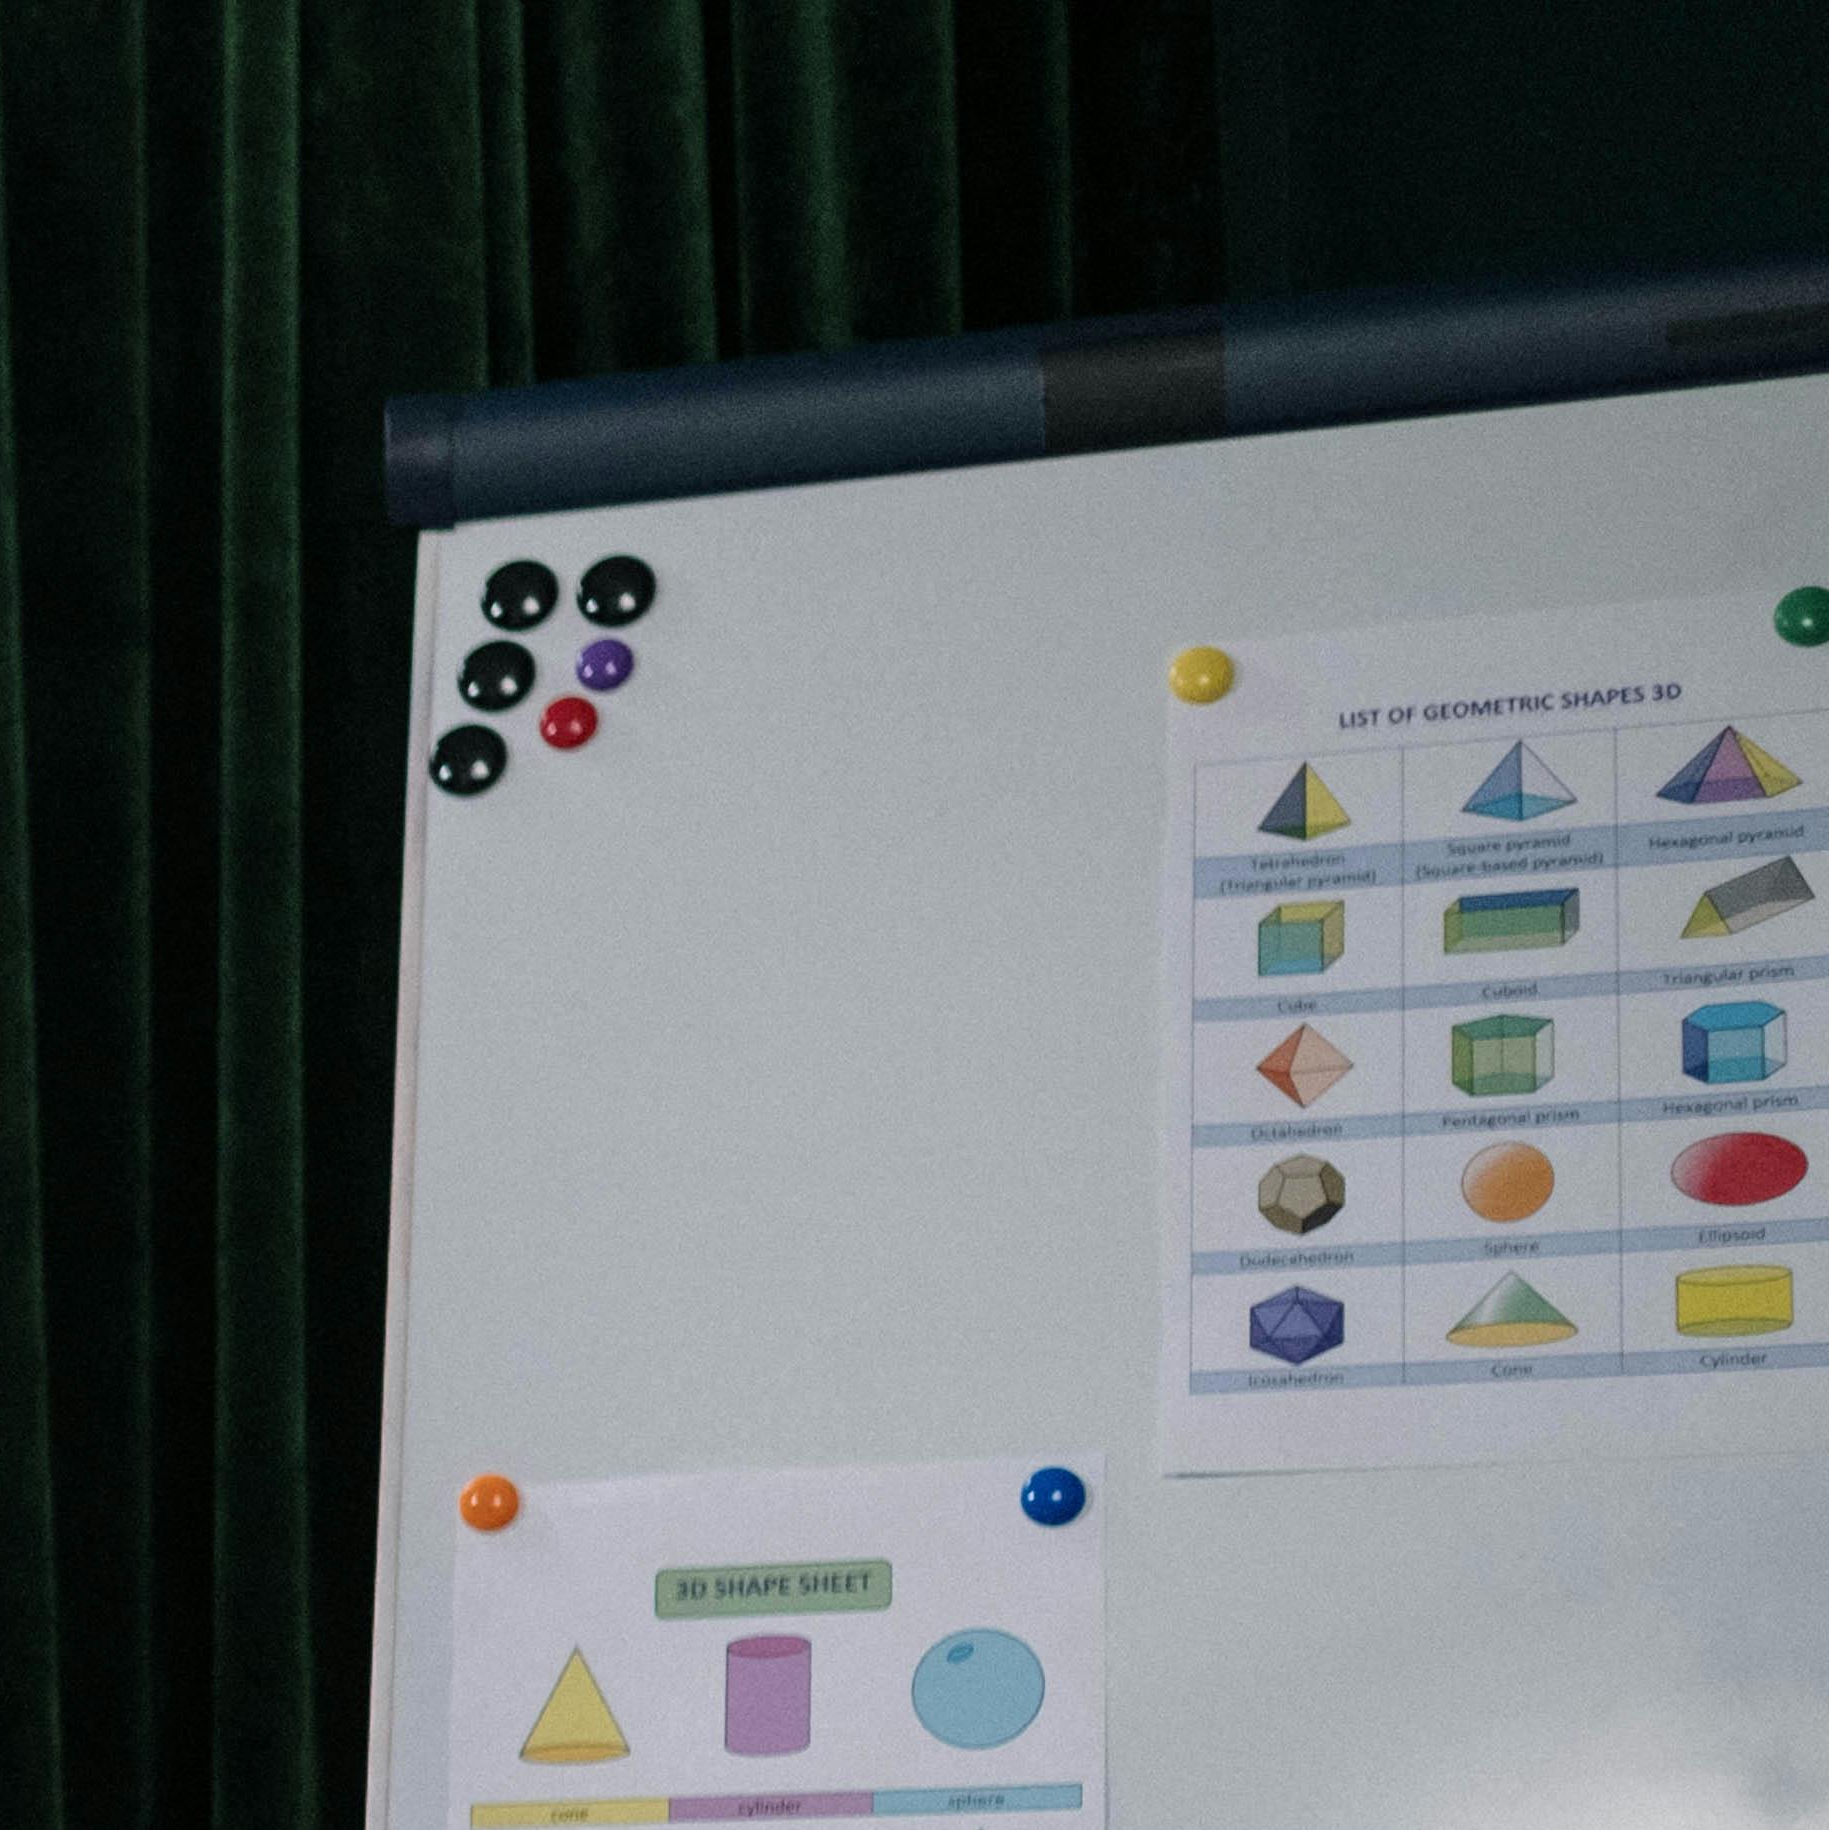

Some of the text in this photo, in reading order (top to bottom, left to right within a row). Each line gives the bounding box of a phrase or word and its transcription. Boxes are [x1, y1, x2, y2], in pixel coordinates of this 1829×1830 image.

[1339, 682, 1681, 729] LIST OF GEOMETRIC SHAPES 3D
[1447, 834, 1571, 857] Square pyramid
[1649, 825, 1805, 849] Hexagonal pyramid
[1250, 854, 1345, 872] Tetrahedron
[1533, 851, 1604, 872] pyramid)
[1220, 870, 1377, 893] (Triangular pyramid)
[1663, 965, 1795, 986] Triangular prism
[1482, 983, 1538, 999] Cuboid
[1277, 999, 1317, 1014] Cube
[1662, 1093, 1799, 1117] Hexagonal prism
[1442, 1108, 1580, 1131] Pentagonal prism
[1250, 1122, 1343, 1140] Octahedron
[1698, 1227, 1766, 1246] Ellipsoid
[1483, 1240, 1540, 1257] Sphere
[1239, 1250, 1354, 1270] Dodecahedron
[1700, 1351, 1767, 1369] Cylinder
[1490, 1362, 1533, 1378] Cone
[1248, 1372, 1344, 1388] Icosahedron
[676, 1573, 872, 1601] 3D SHAPE SHEET
[737, 1798, 802, 1817] cylinder
[947, 1793, 1005, 1810] sphere
[550, 1807, 589, 1822] cone
